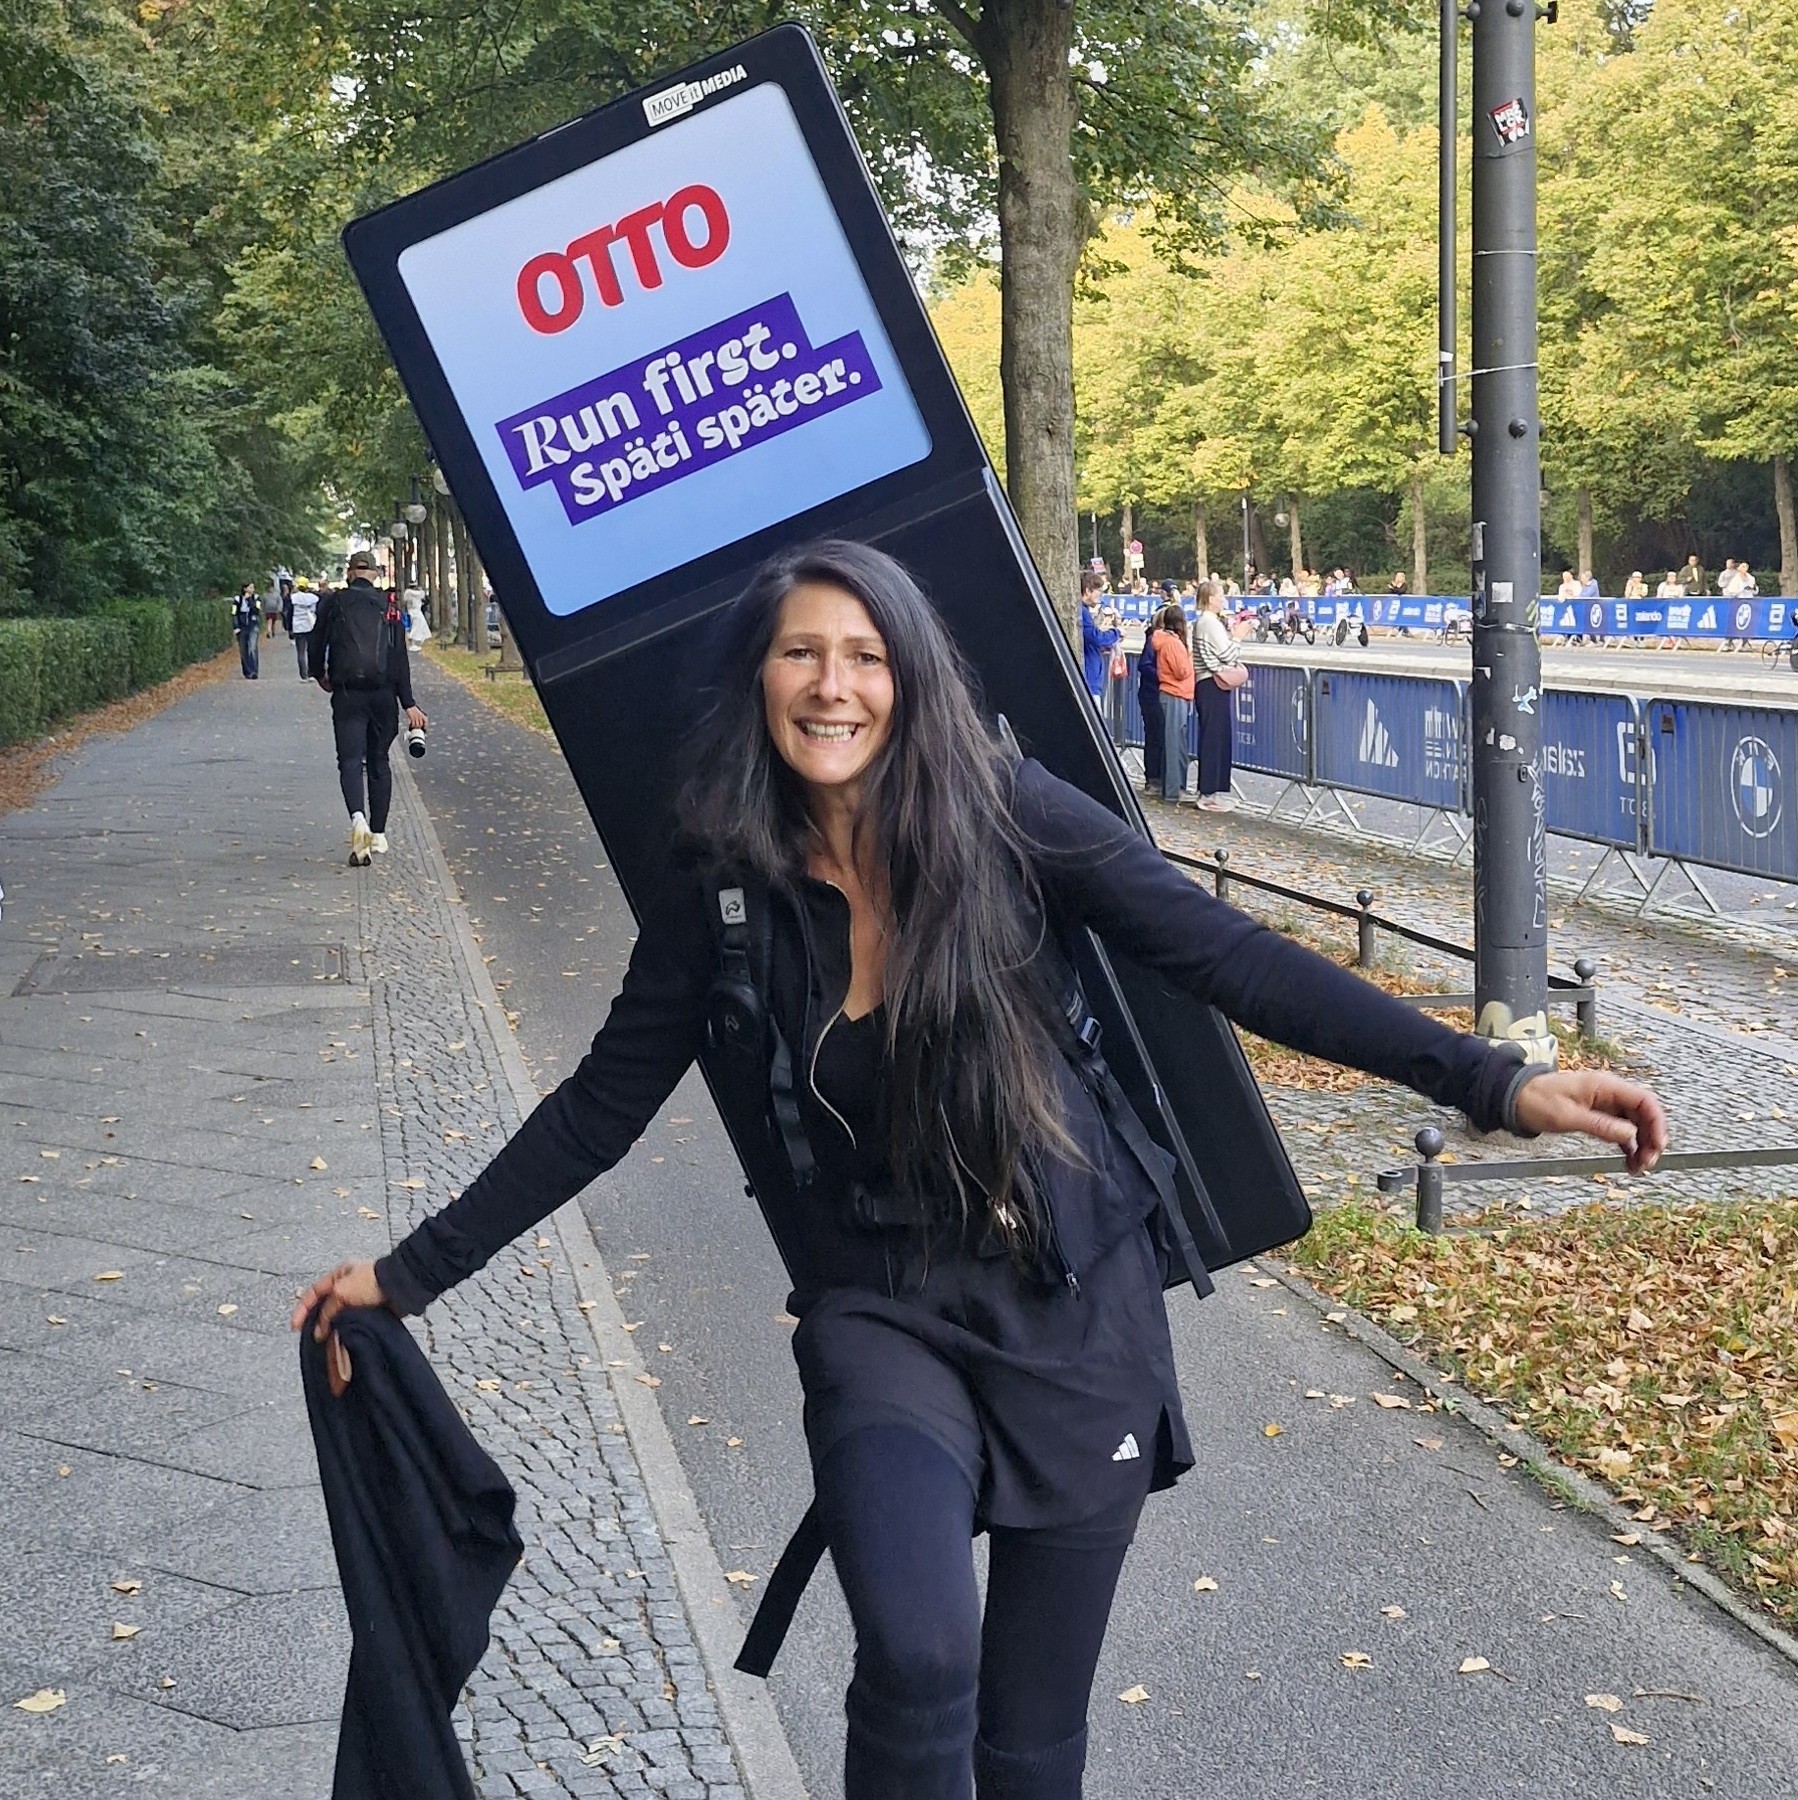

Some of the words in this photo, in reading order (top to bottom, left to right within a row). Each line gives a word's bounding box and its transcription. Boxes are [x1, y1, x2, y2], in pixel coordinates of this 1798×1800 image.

[651, 90, 689, 118] MOVE
[689, 85, 701, 101] it
[701, 64, 748, 96] MEDIA
[516, 184, 730, 335] OTTO
[511, 391, 641, 478] Run
[642, 321, 798, 416] first.
[569, 420, 693, 506] Späti
[696, 358, 862, 449] später.
